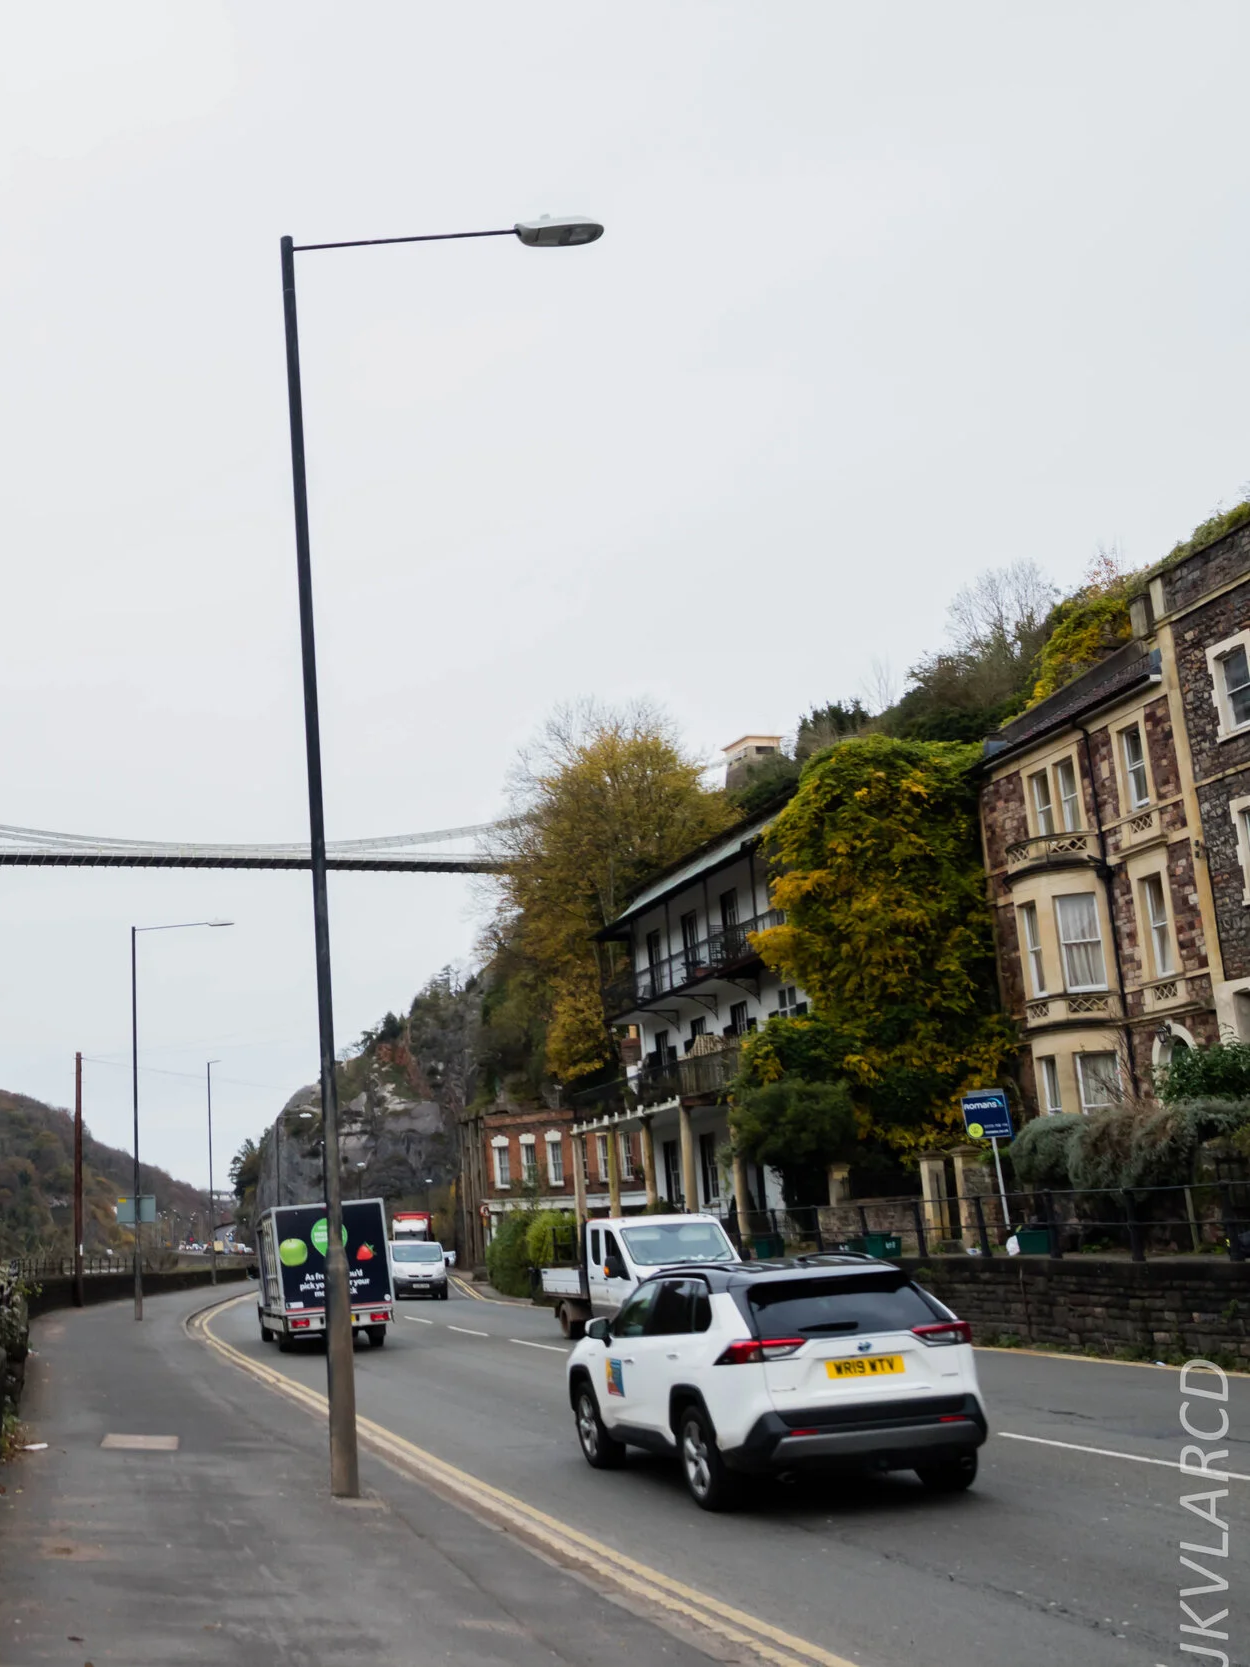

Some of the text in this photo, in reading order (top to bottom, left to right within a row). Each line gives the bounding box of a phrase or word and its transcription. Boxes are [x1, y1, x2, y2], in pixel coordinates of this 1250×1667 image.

[304, 1273, 315, 1282] As
[299, 1282, 315, 1292] pick
[353, 1278, 370, 1287] your
[833, 1357, 894, 1375] WR19 WTV
